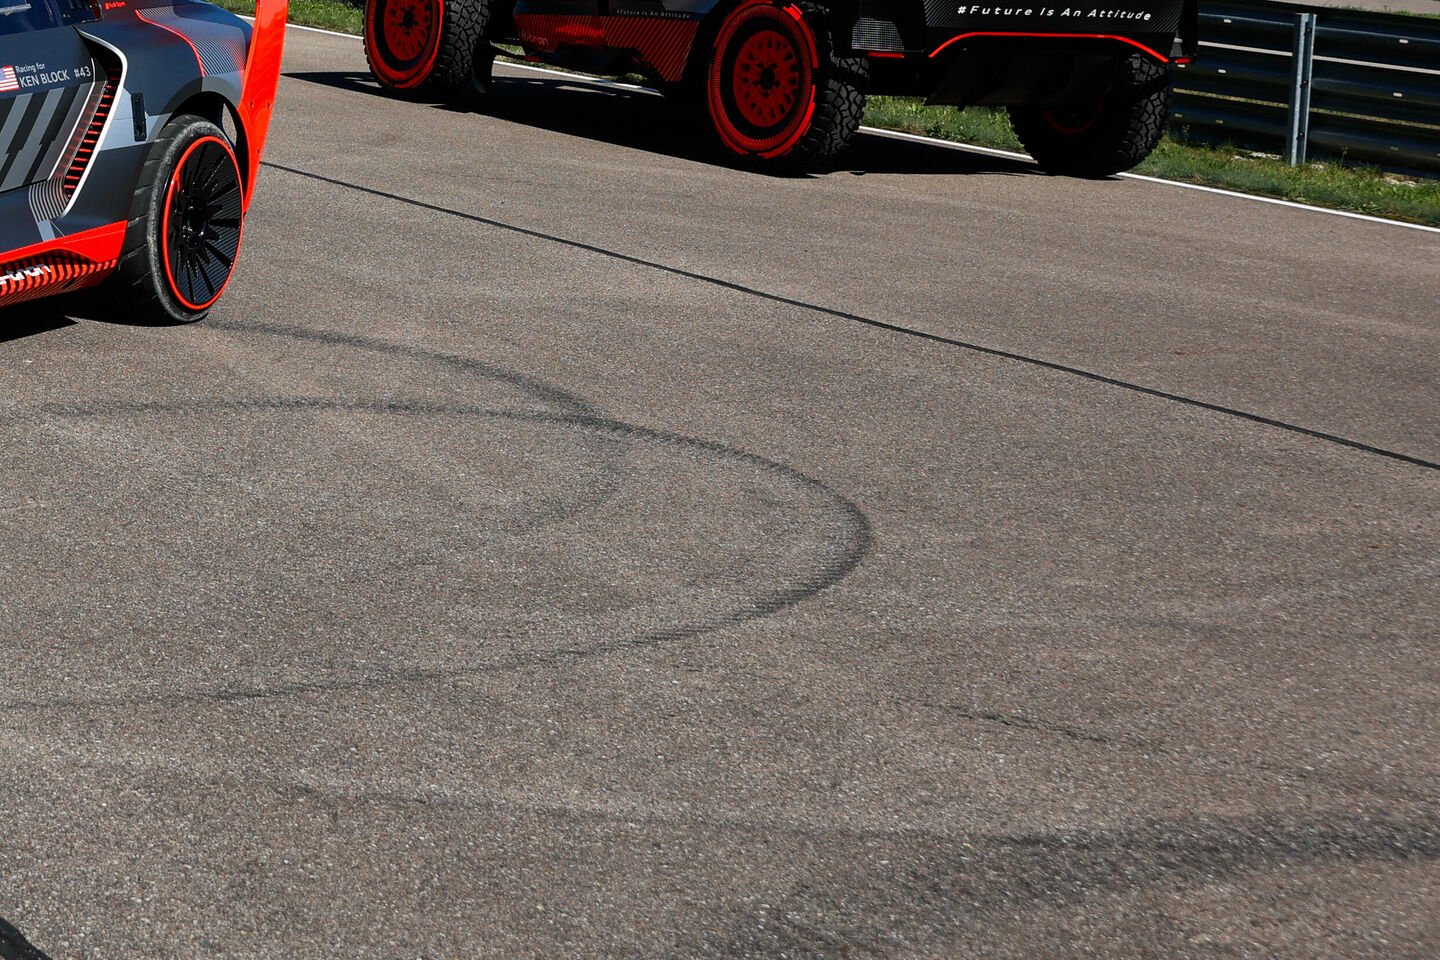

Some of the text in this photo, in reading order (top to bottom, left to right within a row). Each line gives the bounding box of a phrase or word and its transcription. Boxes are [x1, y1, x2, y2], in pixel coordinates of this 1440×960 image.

[660, 11, 690, 19] Attitude
[957, 5, 1152, 21] #Future Is An Attitude
[15, 62, 45, 74] Racing for
[19, 66, 91, 88] KEN BLOCK #43
